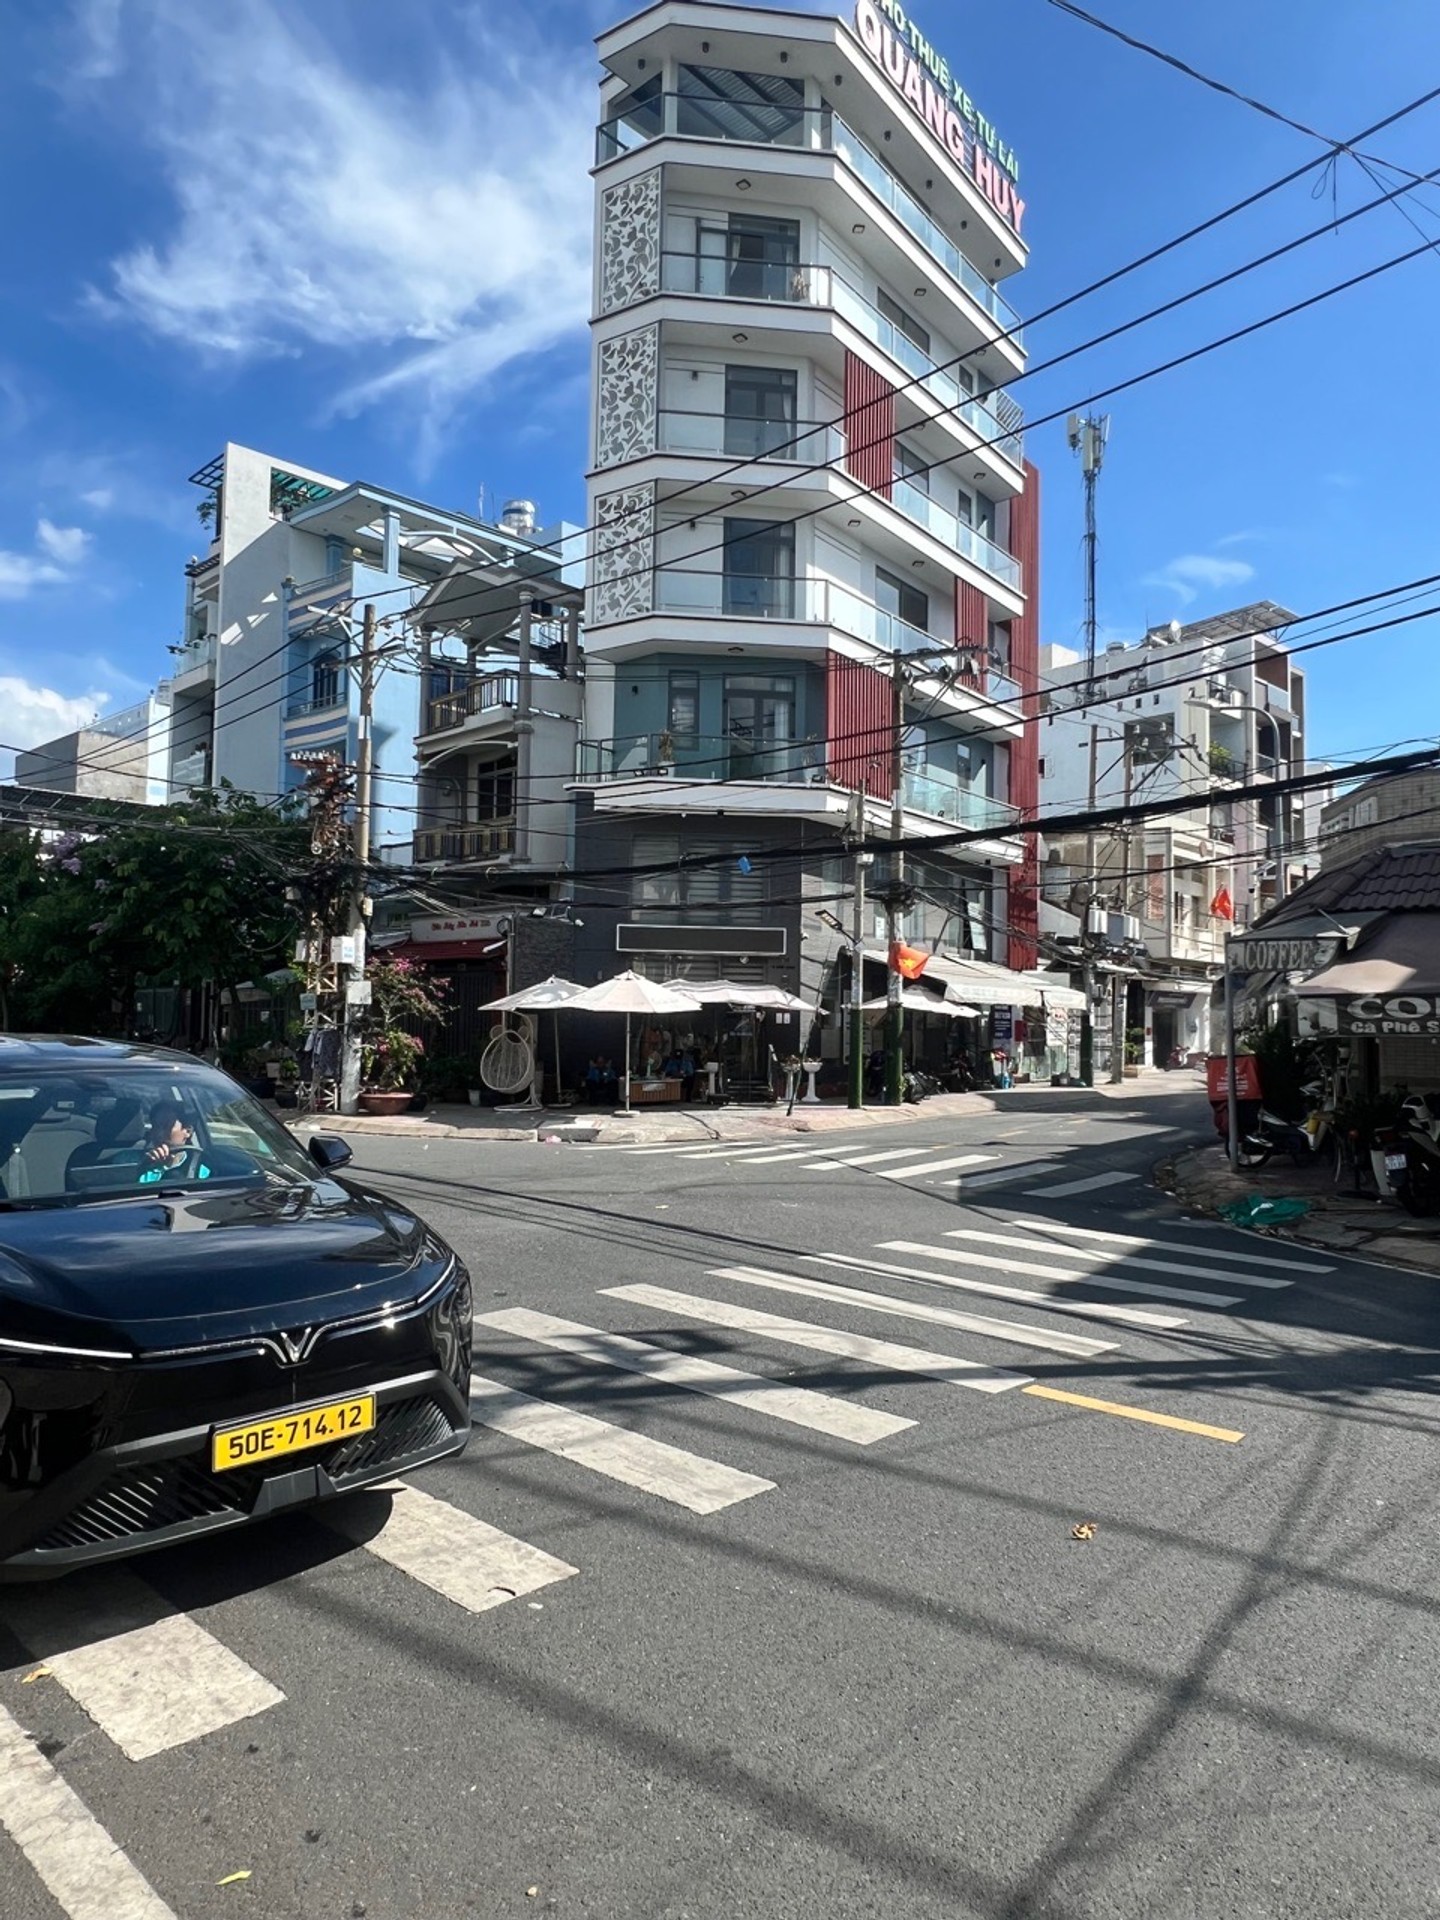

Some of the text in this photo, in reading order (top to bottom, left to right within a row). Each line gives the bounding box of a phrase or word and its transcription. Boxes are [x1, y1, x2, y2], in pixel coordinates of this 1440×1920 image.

[874, 0, 1019, 182] HO THUÊ XE TỰ LÁI
[856, 0, 1025, 234] QUANG HUY
[1246, 940, 1315, 970] COFFEE
[1347, 997, 1440, 1019] CO
[1382, 1020, 1420, 1034] Phê
[229, 1405, 362, 1459] 50E-714.12
